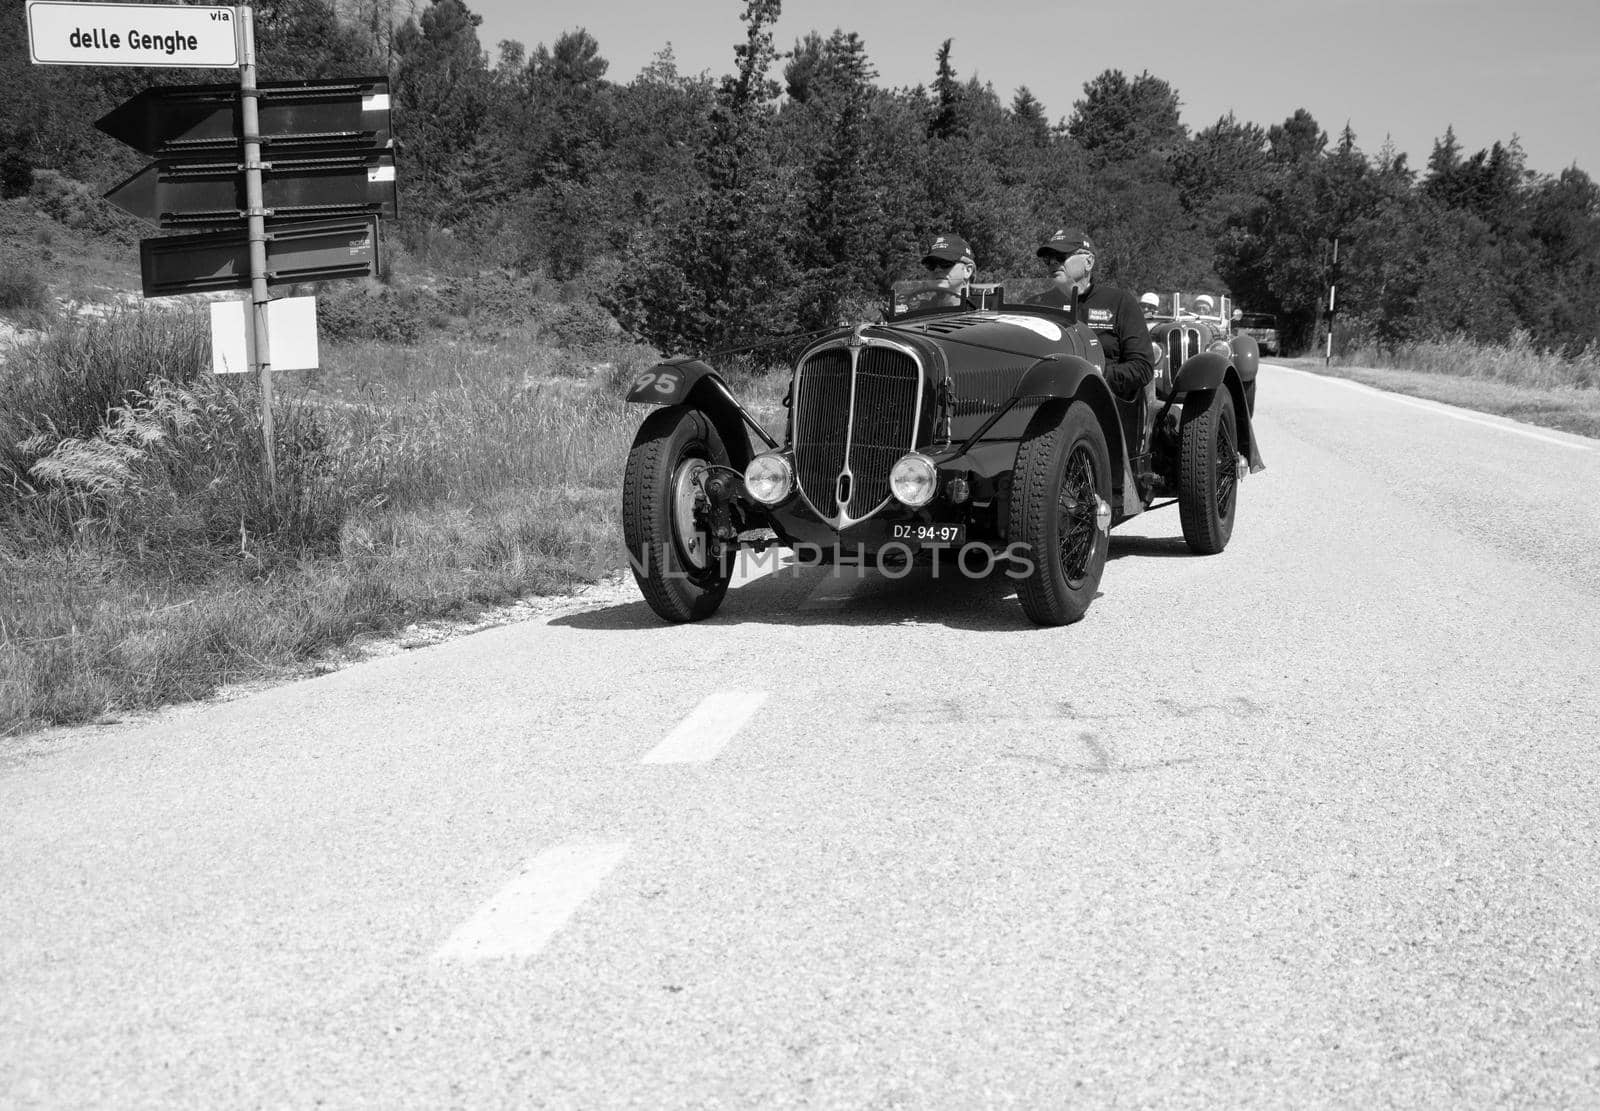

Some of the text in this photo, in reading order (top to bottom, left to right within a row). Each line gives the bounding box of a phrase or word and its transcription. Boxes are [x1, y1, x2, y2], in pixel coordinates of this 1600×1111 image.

[210, 10, 230, 21] via
[69, 27, 198, 55] delle Genghe
[635, 373, 679, 394] 95
[893, 524, 959, 541] DZ-94-97
